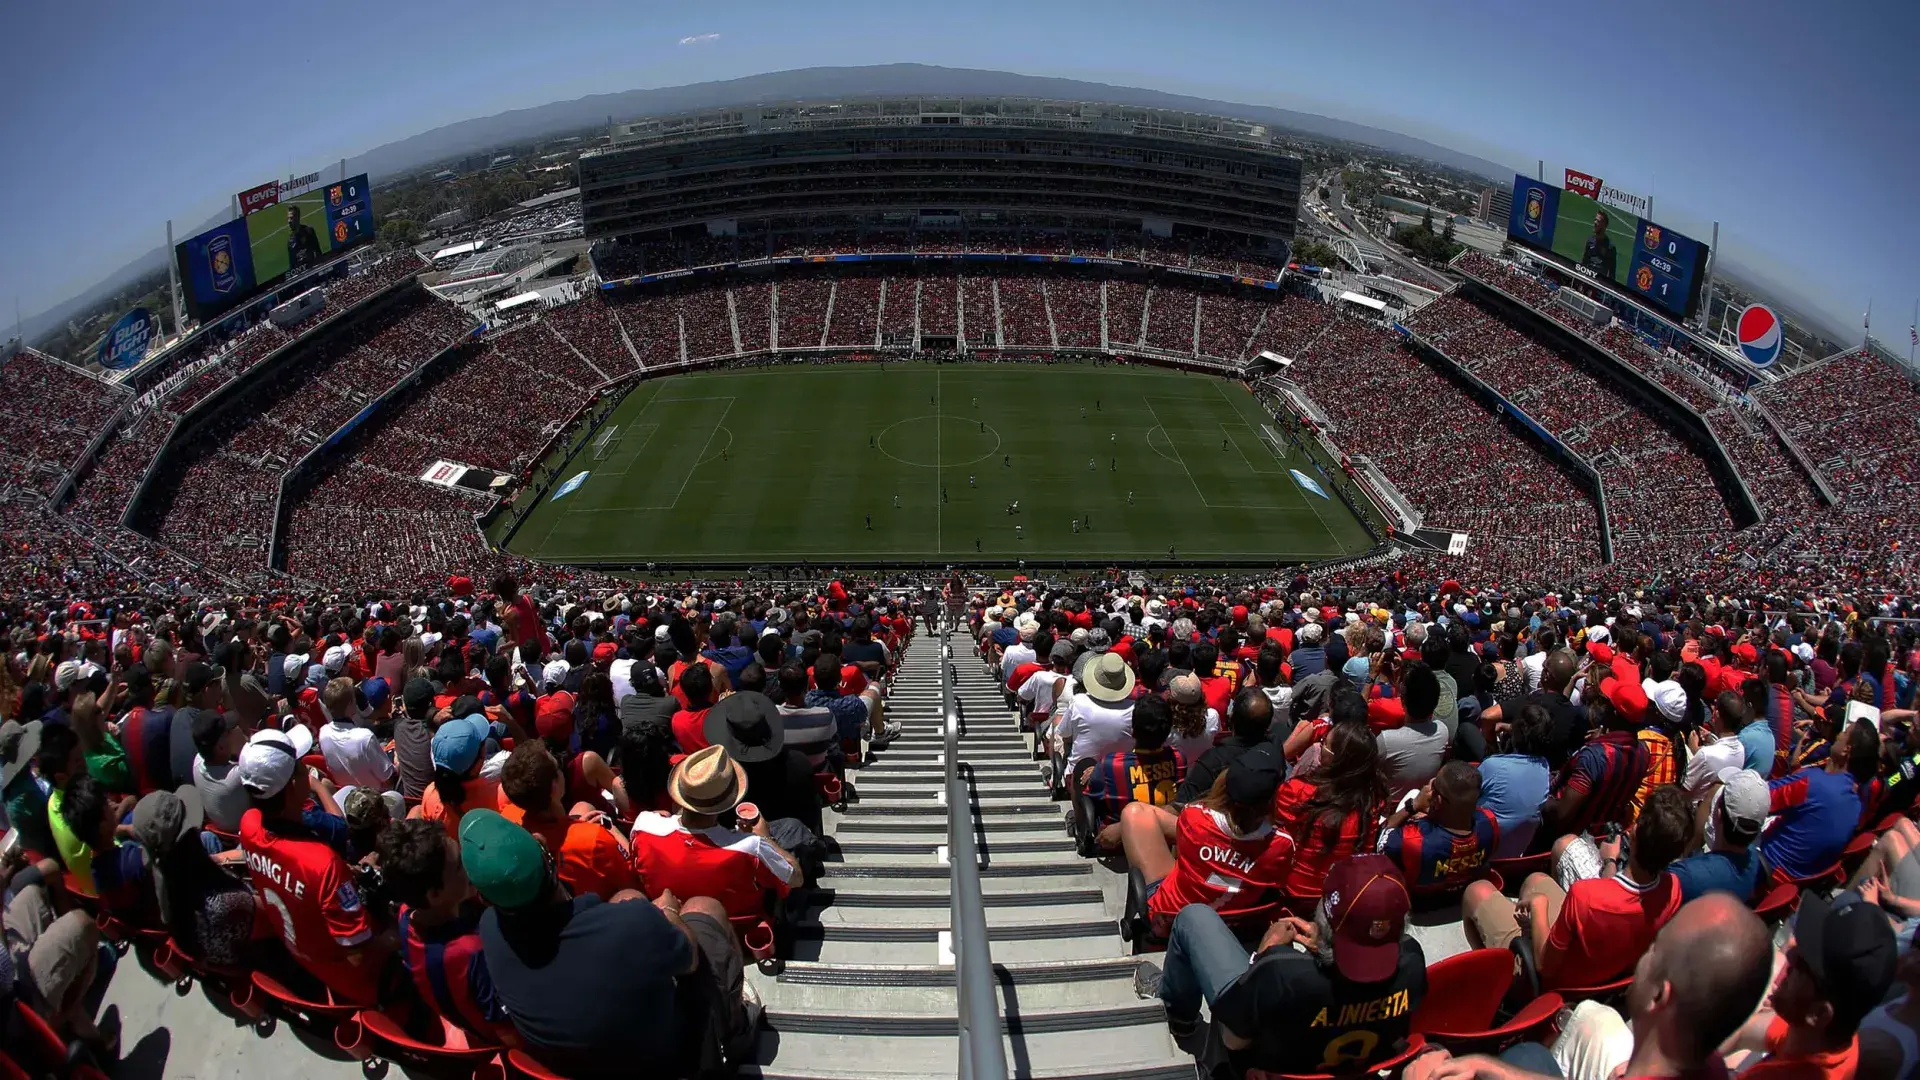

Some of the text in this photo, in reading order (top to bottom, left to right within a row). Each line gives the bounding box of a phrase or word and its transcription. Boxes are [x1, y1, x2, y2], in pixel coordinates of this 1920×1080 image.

[280, 172, 320, 193] STADIUM
[349, 186, 356, 197] 0
[1602, 186, 1646, 210] STADIUM
[341, 205, 357, 216] 42:39
[354, 220, 360, 230] 1
[1668, 241, 1676, 255] 0
[1575, 263, 1598, 279] SONY
[1650, 257, 1672, 273] 42:39
[1661, 283, 1668, 295] 1
[115, 319, 145, 345] BUD
[111, 327, 150, 360] LIGHT
[1129, 760, 1175, 784] MESSI
[1199, 845, 1256, 874] OWEN
[1433, 848, 1486, 878] MESSI
[284, 872, 305, 900] LE
[1310, 988, 1408, 1027] A. INIESTA
